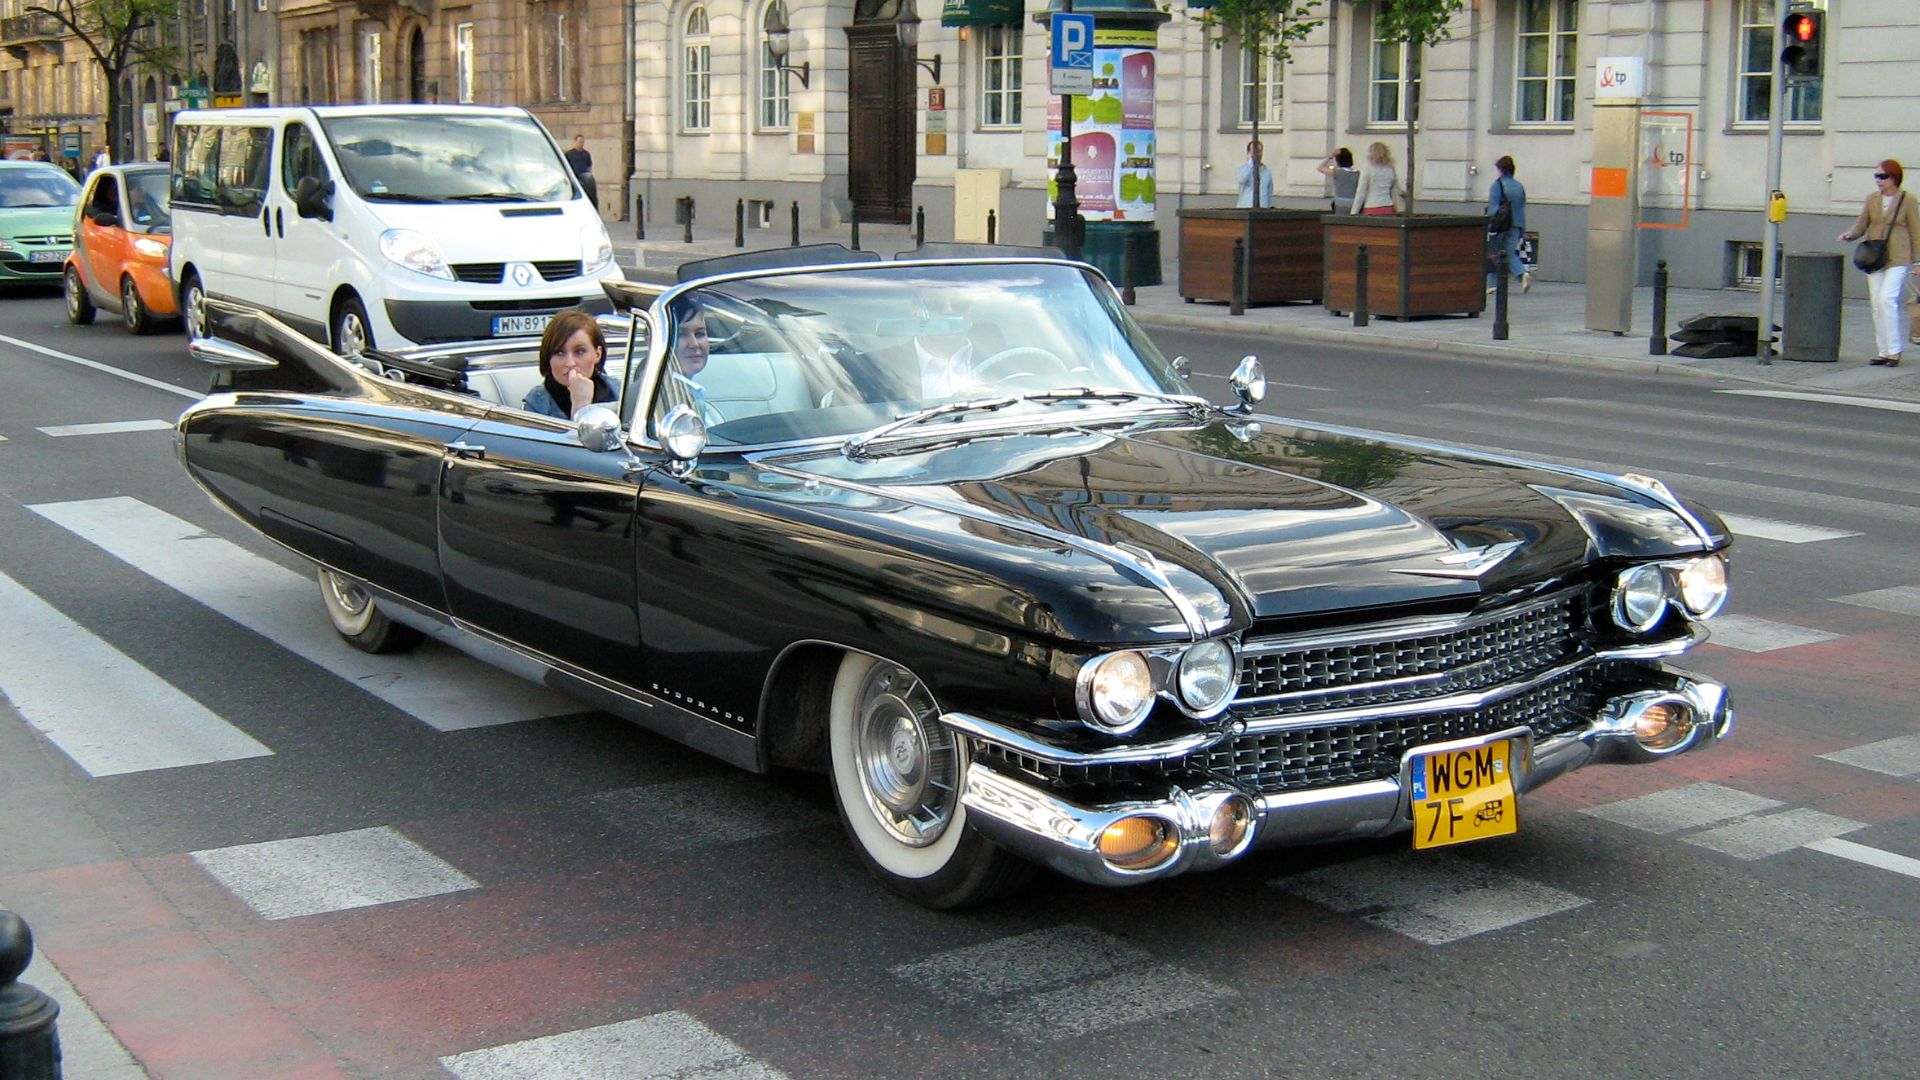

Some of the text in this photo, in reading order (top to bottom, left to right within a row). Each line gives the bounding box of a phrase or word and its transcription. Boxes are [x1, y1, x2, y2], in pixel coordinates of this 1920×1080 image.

[1061, 20, 1086, 62] P
[1615, 72, 1627, 85] tp
[179, 88, 207, 97] APTEKA
[1669, 151, 1684, 166] tp
[501, 317, 520, 332] WN
[652, 683, 745, 723] ELDORADO
[1432, 746, 1495, 794] WGM
[1413, 781, 1425, 794] PL
[1426, 797, 1464, 843] 7F
